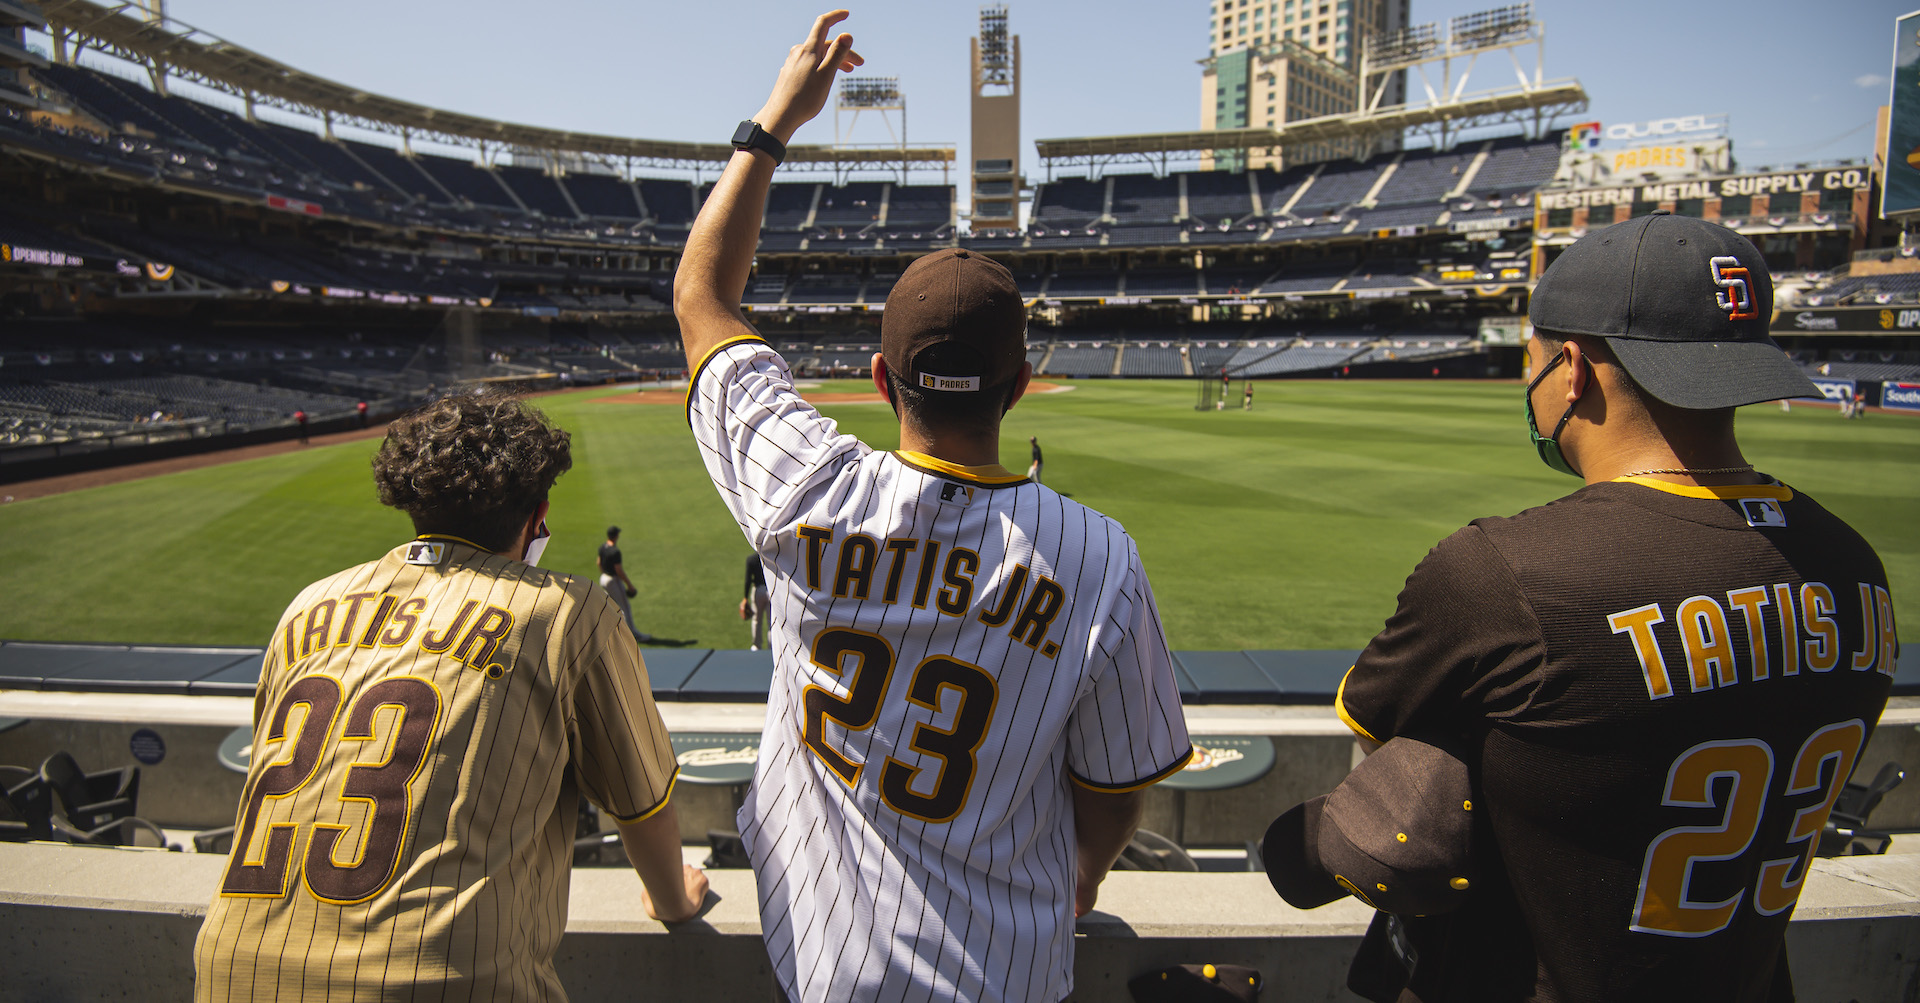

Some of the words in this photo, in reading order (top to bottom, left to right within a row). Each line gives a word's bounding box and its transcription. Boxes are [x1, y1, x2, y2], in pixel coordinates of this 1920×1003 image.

[1606, 115, 1719, 139] QUIDEL
[1540, 188, 1634, 210] WESTERN
[1642, 182, 1716, 202] METAL
[1721, 173, 1814, 197] SUPPLY
[1823, 170, 1867, 190] CO.
[1614, 147, 1686, 173] PADRES
[13, 246, 49, 264] OPENING
[50, 250, 66, 266] DAY
[940, 380, 970, 389] PADRES
[1887, 388, 1920, 404] South
[797, 524, 981, 618] TATIS
[977, 563, 1066, 660] JR.
[283, 591, 428, 671] TATIS
[419, 600, 505, 680] JR.
[1606, 582, 1840, 700] TATIS
[802, 626, 1000, 824] 23
[220, 674, 443, 905] 23
[1629, 718, 1866, 938] 23
